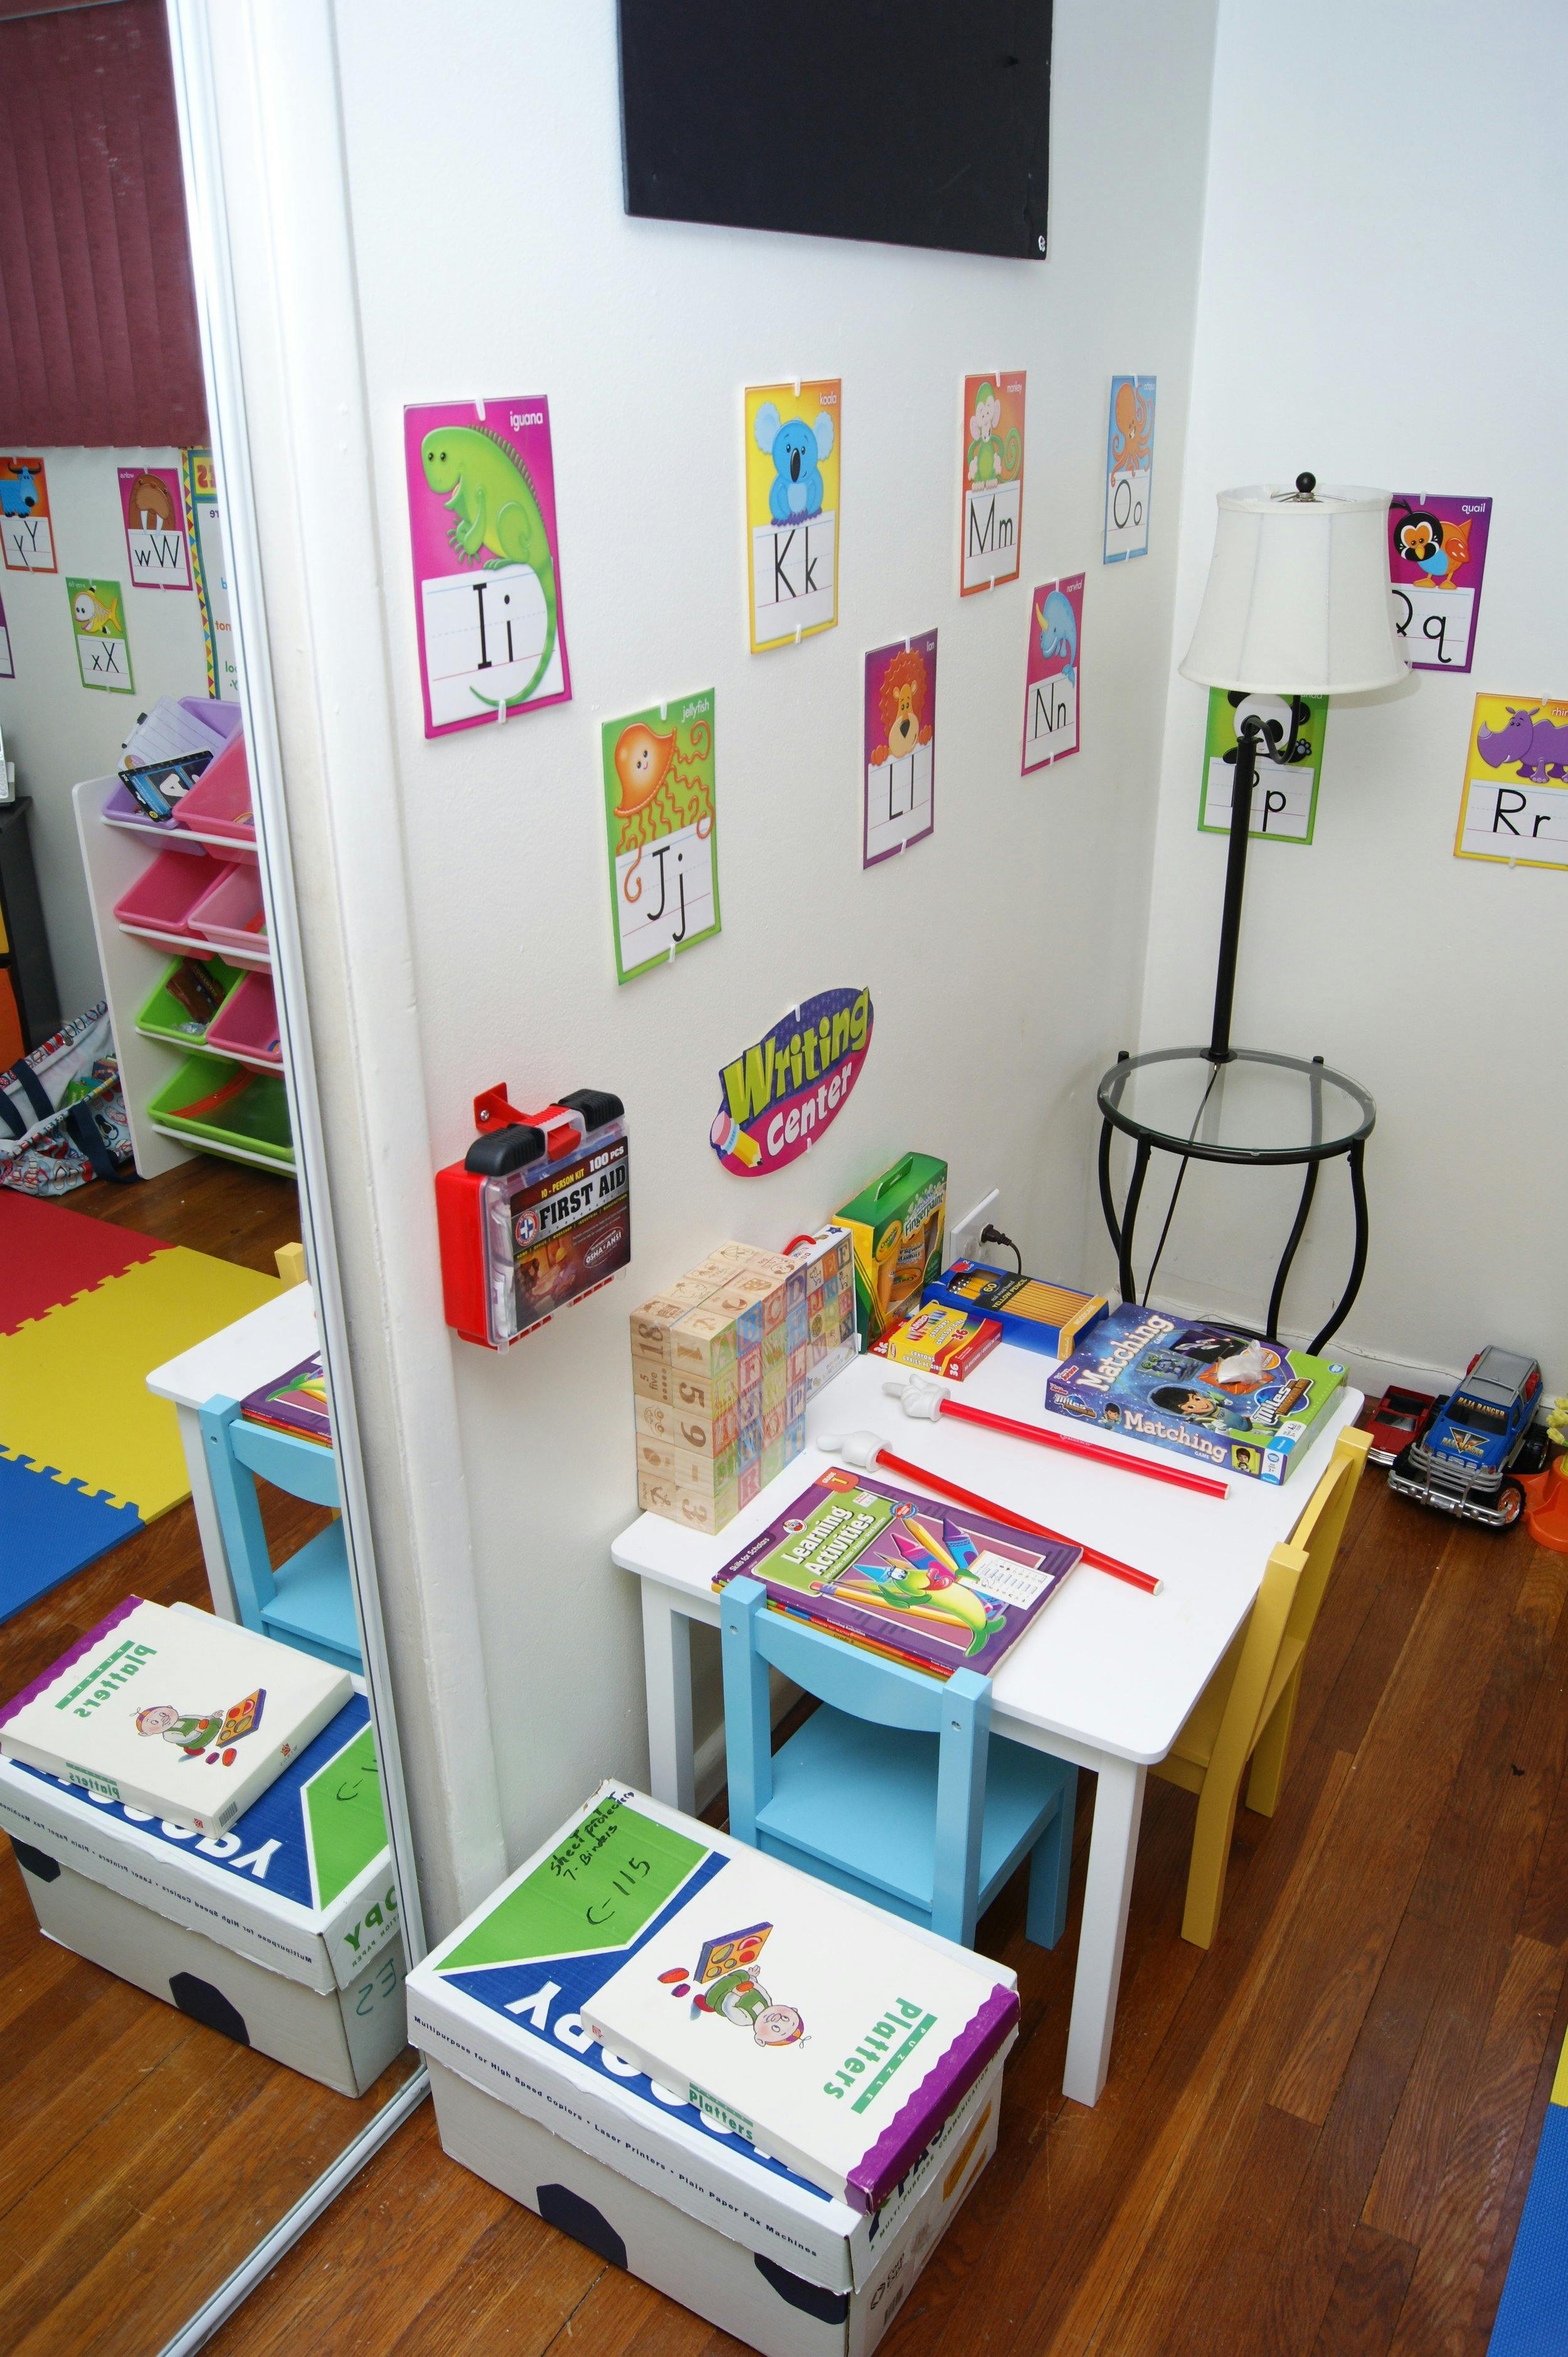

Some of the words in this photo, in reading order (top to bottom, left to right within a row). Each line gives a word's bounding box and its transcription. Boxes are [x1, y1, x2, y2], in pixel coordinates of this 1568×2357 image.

[818, 391, 838, 407] koala
[1006, 383, 1023, 395] monkey
[509, 410, 544, 432] iguana
[1113, 479, 1143, 530] Oo
[1461, 501, 1486, 515] quail
[968, 494, 1014, 558] Mm
[772, 525, 819, 604] Kk
[1065, 578, 1083, 594] narwhal
[472, 582, 514, 671] Ii
[925, 639, 936, 653] lion
[681, 699, 710, 723] jellyfish
[1033, 681, 1067, 740] Nn
[1492, 788, 1552, 839] Rr
[646, 845, 686, 943] Jj
[722, 986, 871, 1125] Writing
[589, 1152, 609, 1173] 100
[610, 1146, 625, 1159] PCS
[552, 1173, 574, 1193] PERSON
[575, 1168, 585, 1180] KIT
[539, 1182, 594, 1232] FIRST
[598, 1164, 626, 1198] AID
[904, 1193, 944, 1237] Fingerpaint
[585, 1248, 603, 1264] OSHA
[606, 1231, 622, 1250] ANSI
[983, 1282, 998, 1293] 60
[991, 1292, 1014, 1309] YELLOW
[1011, 1278, 1029, 1294] PENCIL
[638, 1322, 664, 1359] 18
[929, 1319, 950, 1338] CRAYONS
[951, 1328, 970, 1341] 36
[1153, 1332, 1168, 1345] GAME
[873, 1341, 889, 1354] 36
[910, 1350, 936, 1363] CRAYONS
[1076, 1314, 1177, 1392] Matching
[650, 1371, 658, 1391] five
[949, 1362, 959, 1377] 36
[679, 1381, 705, 1408] 5
[1054, 1393, 1087, 1410] Miles
[1252, 1386, 1292, 1423] Miles
[1457, 1397, 1476, 1410] BAJA
[1476, 1403, 1507, 1418] RANGER
[1123, 1410, 1229, 1464] Matching
[1194, 1451, 1210, 1460] GAME
[832, 1477, 849, 1485] 1
[682, 1498, 708, 1523] 3
[780, 1506, 854, 1565] Learning
[803, 1513, 876, 1577] Activities
[729, 1559, 744, 1572] Skills
[740, 1554, 751, 1562] for
[746, 1537, 770, 1556] Scholars
[580, 1824, 618, 1867] Binders
[586, 1856, 651, 1926] C-115
[822, 1996, 924, 2101] Platters
[865, 2027, 926, 2102] PUZZLE
[689, 2089, 755, 2141] Platters
[413, 2015, 471, 2055] Multipurpose
[474, 2052, 489, 2065] for
[490, 2062, 512, 2079] High
[514, 2076, 543, 2098] Speed
[546, 2095, 583, 2122] Copiers
[594, 2123, 622, 2144] Laser
[625, 2142, 667, 2171] Printers
[679, 2173, 706, 2195] Plain
[709, 2189, 740, 2215] Paper
[743, 2211, 761, 2227] Fax
[765, 2223, 818, 2257] Machines
[879, 2153, 935, 2238] MULTI-PURPOSE
[938, 2065, 990, 2150] COMMUNICATION
